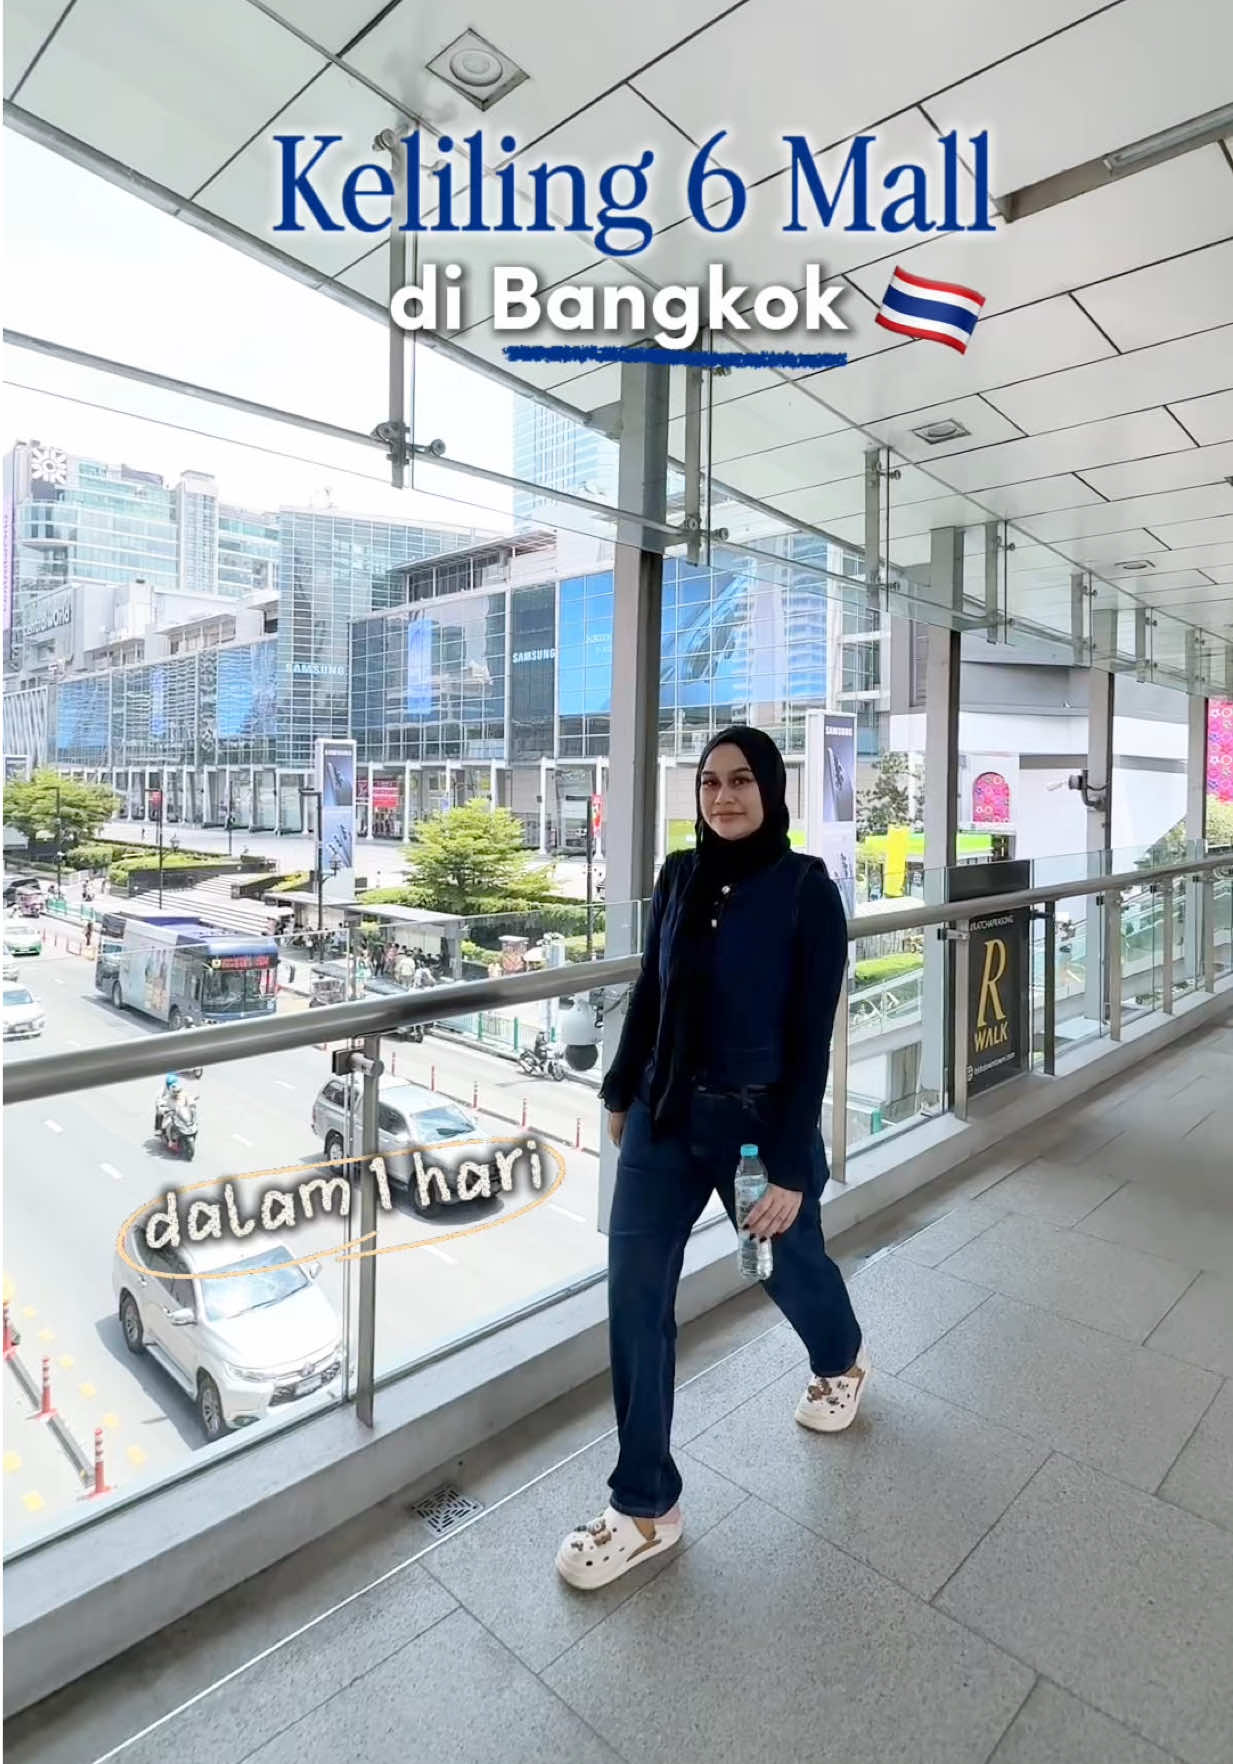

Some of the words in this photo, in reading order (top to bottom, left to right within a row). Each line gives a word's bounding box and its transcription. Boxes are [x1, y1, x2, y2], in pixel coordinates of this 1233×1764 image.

[512, 648, 556, 664] SAMSUNG
[977, 938, 1007, 1027] R
[974, 1021, 1008, 1053] WALK
